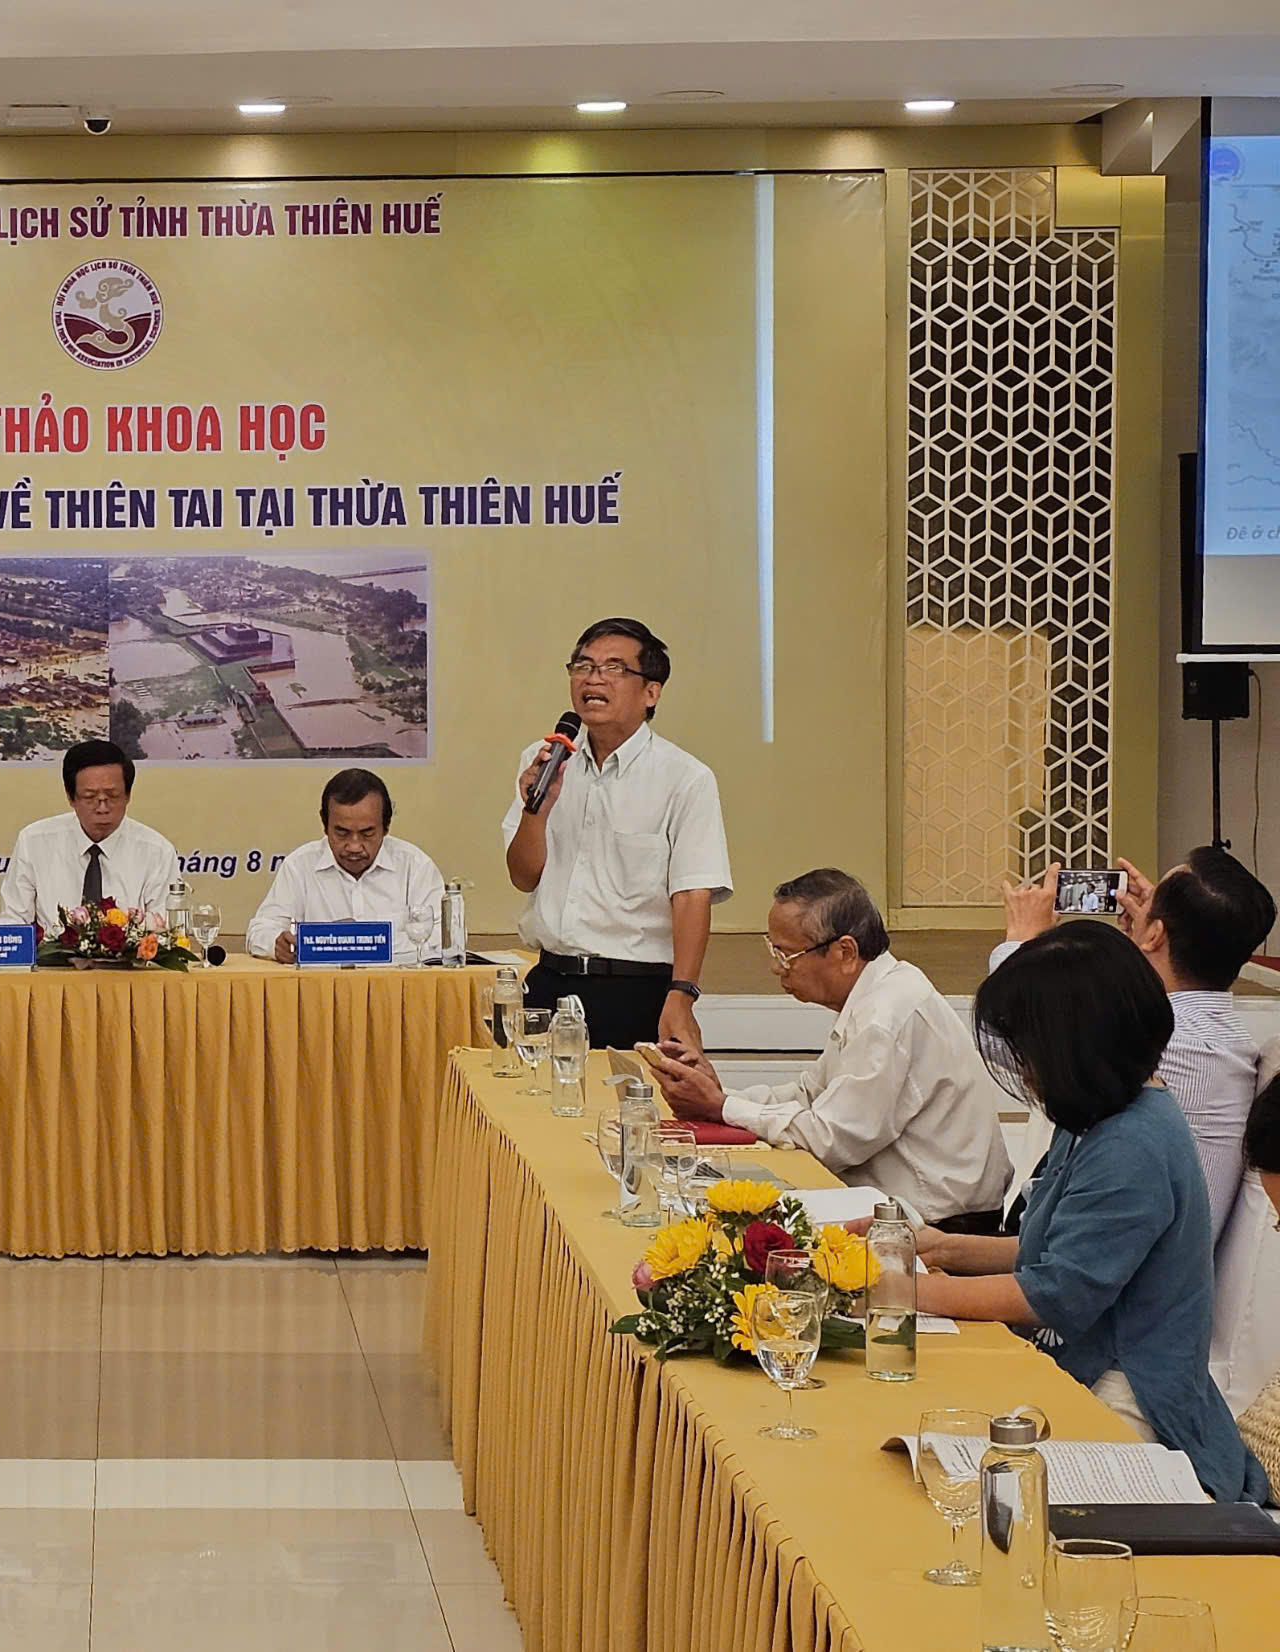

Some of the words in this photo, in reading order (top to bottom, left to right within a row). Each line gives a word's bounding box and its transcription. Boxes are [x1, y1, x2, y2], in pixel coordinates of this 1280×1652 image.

[70, 196, 112, 240] SỬ
[119, 196, 188, 238] TỈNH
[197, 199, 275, 237] THỪA
[285, 197, 372, 235] THIÊN
[383, 192, 443, 235] HUẾ
[106, 406, 222, 452] KHOA
[239, 404, 326, 462] HỌC
[45, 481, 155, 529] THIÊN
[169, 487, 230, 529] TAI
[236, 487, 294, 536] TẠI
[308, 478, 407, 527] THỪA
[419, 477, 531, 526] THIÊN
[545, 471, 623, 524] HUẾ
[176, 850, 237, 878] háng
[247, 851, 261, 872] 8
